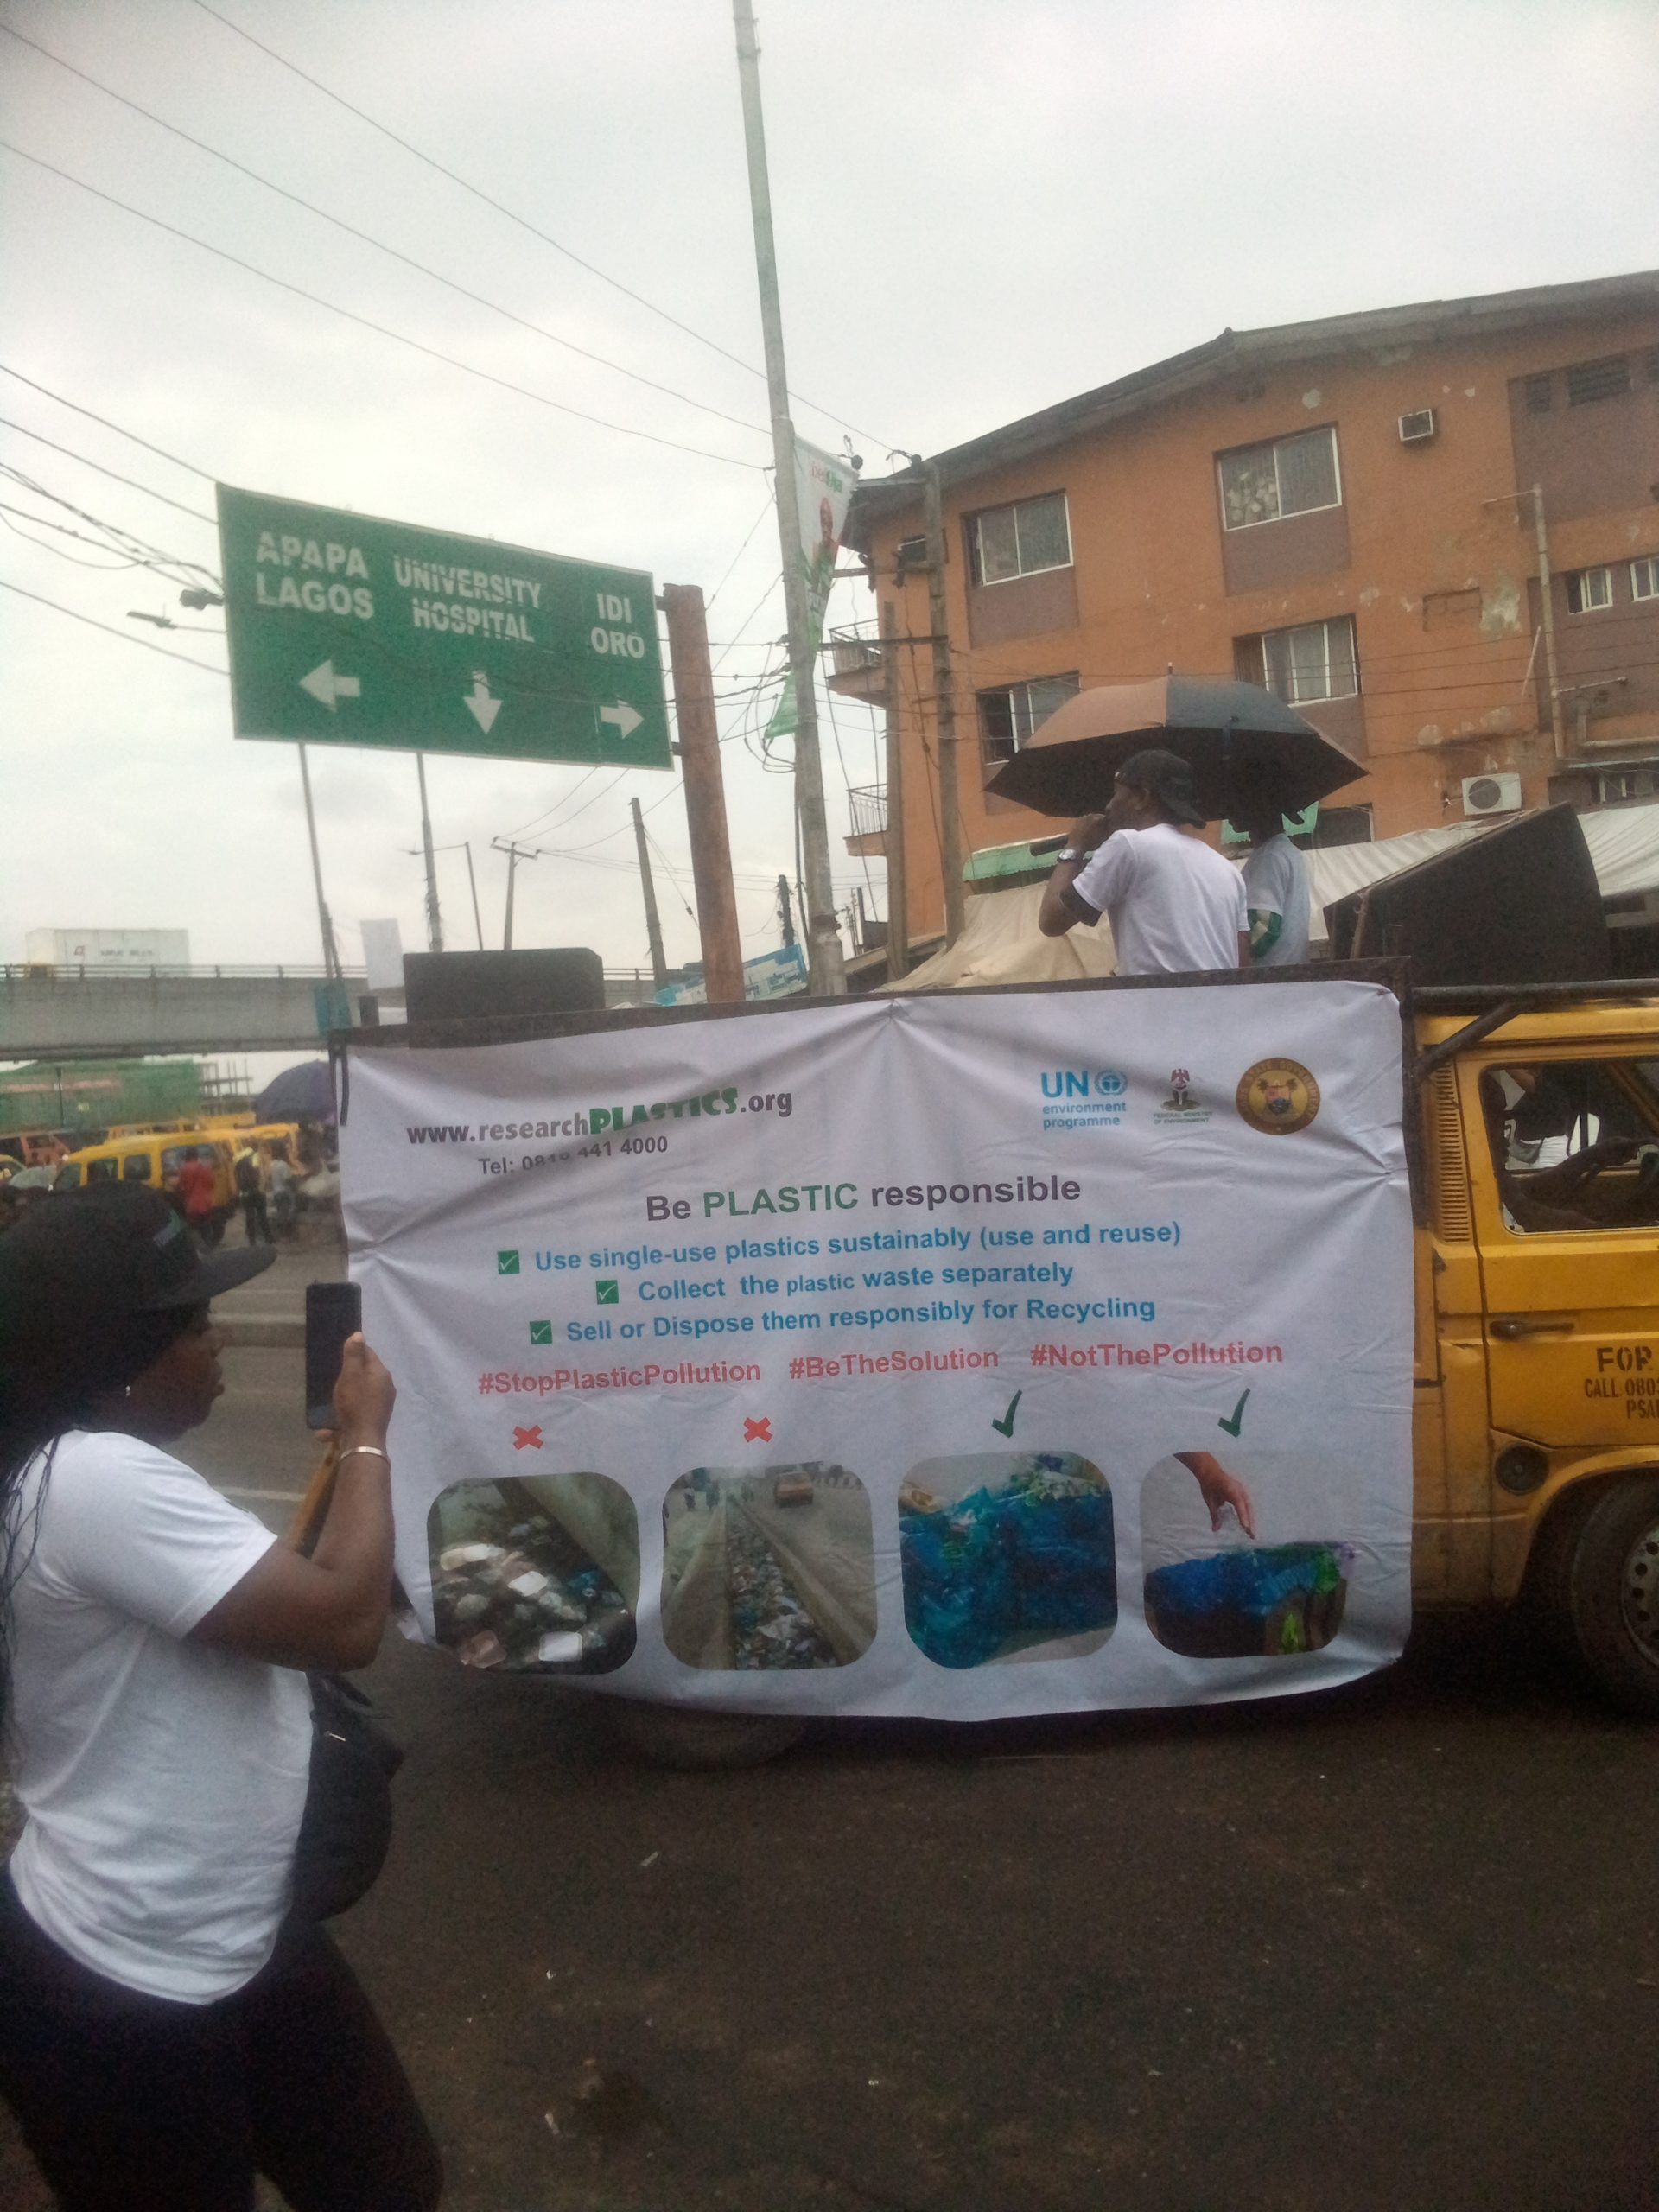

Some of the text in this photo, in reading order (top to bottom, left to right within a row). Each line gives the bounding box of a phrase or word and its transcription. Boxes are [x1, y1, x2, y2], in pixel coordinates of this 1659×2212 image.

[256, 531, 369, 579] APAPA
[257, 573, 374, 620] LAGOS
[393, 555, 542, 608] UNIVERSITY
[413, 598, 534, 642] HOSPITAL
[597, 593, 632, 623] IDI
[591, 627, 645, 658] ORO
[1040, 1071, 1089, 1098] UN
[1042, 1102, 1127, 1115] environment
[1044, 1117, 1120, 1131] programme
[478, 1158, 514, 1176] Tel:
[577, 1140, 612, 1157] 441
[620, 1135, 668, 1155] 4000
[646, 1174, 1082, 1221] Be PLASTIC responsible
[535, 1221, 1181, 1271] Use single-use plastics sustainably (use and reuse)
[639, 1262, 1074, 1301] Collect the plastic waste separately
[566, 1298, 1155, 1342] Sell or Dispose them responsibly for Recycling
[479, 1341, 1283, 1396] #StopPlasticPollution #BeTheSolution #NotThePollution
[1585, 1378, 1619, 1398] CALL
